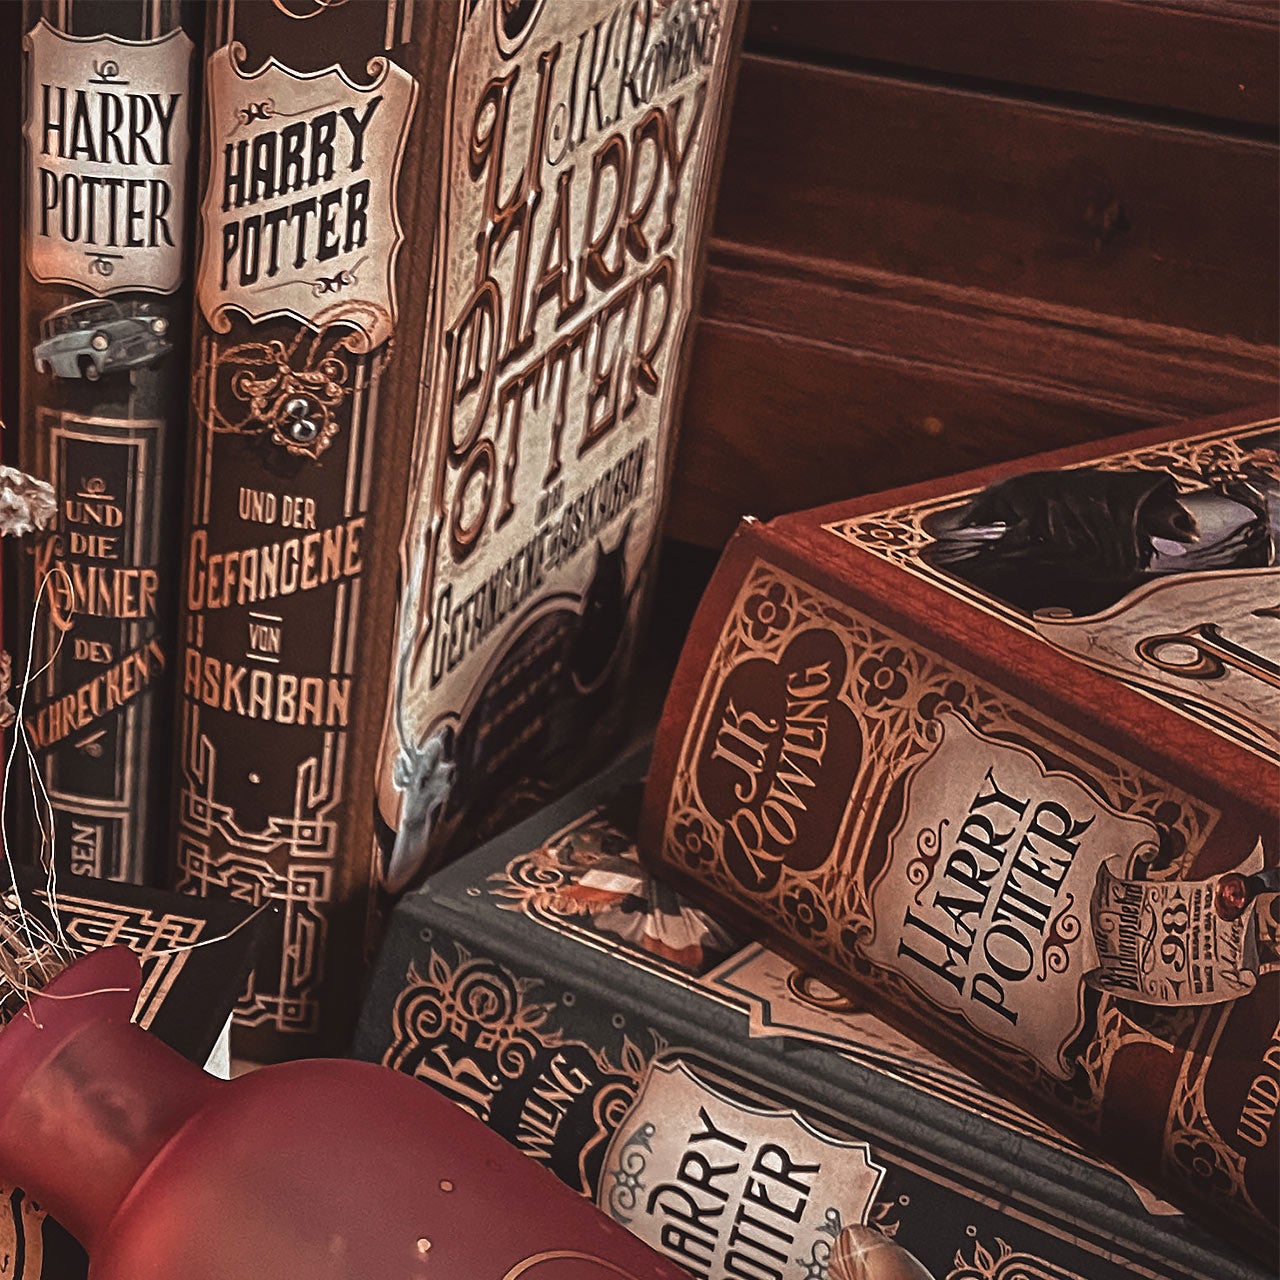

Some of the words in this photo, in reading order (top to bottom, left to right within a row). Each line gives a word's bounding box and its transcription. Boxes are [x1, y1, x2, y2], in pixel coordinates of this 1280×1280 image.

[39, 84, 182, 165] HARRY
[223, 95, 383, 212] HARRY
[39, 167, 176, 248] POTTER
[221, 178, 371, 291] POTTER
[468, 42, 708, 362] HARRY
[66, 500, 123, 527] UND
[239, 487, 277, 524] UND
[281, 495, 317, 530] DER
[410, 255, 674, 690] POTTER
[27, 533, 160, 631] KAMMER
[70, 532, 119, 559] DIE
[188, 517, 367, 611] GEFANGENE
[73, 638, 114, 664] DES
[248, 623, 281, 653] VON
[184, 648, 352, 727] ASKABAN
[724, 660, 833, 884] ROWLING
[897, 766, 1031, 996] HARRY
[971, 800, 1097, 1027] POTTER
[1161, 903, 1188, 972] 98
[516, 1053, 594, 1159] WLING
